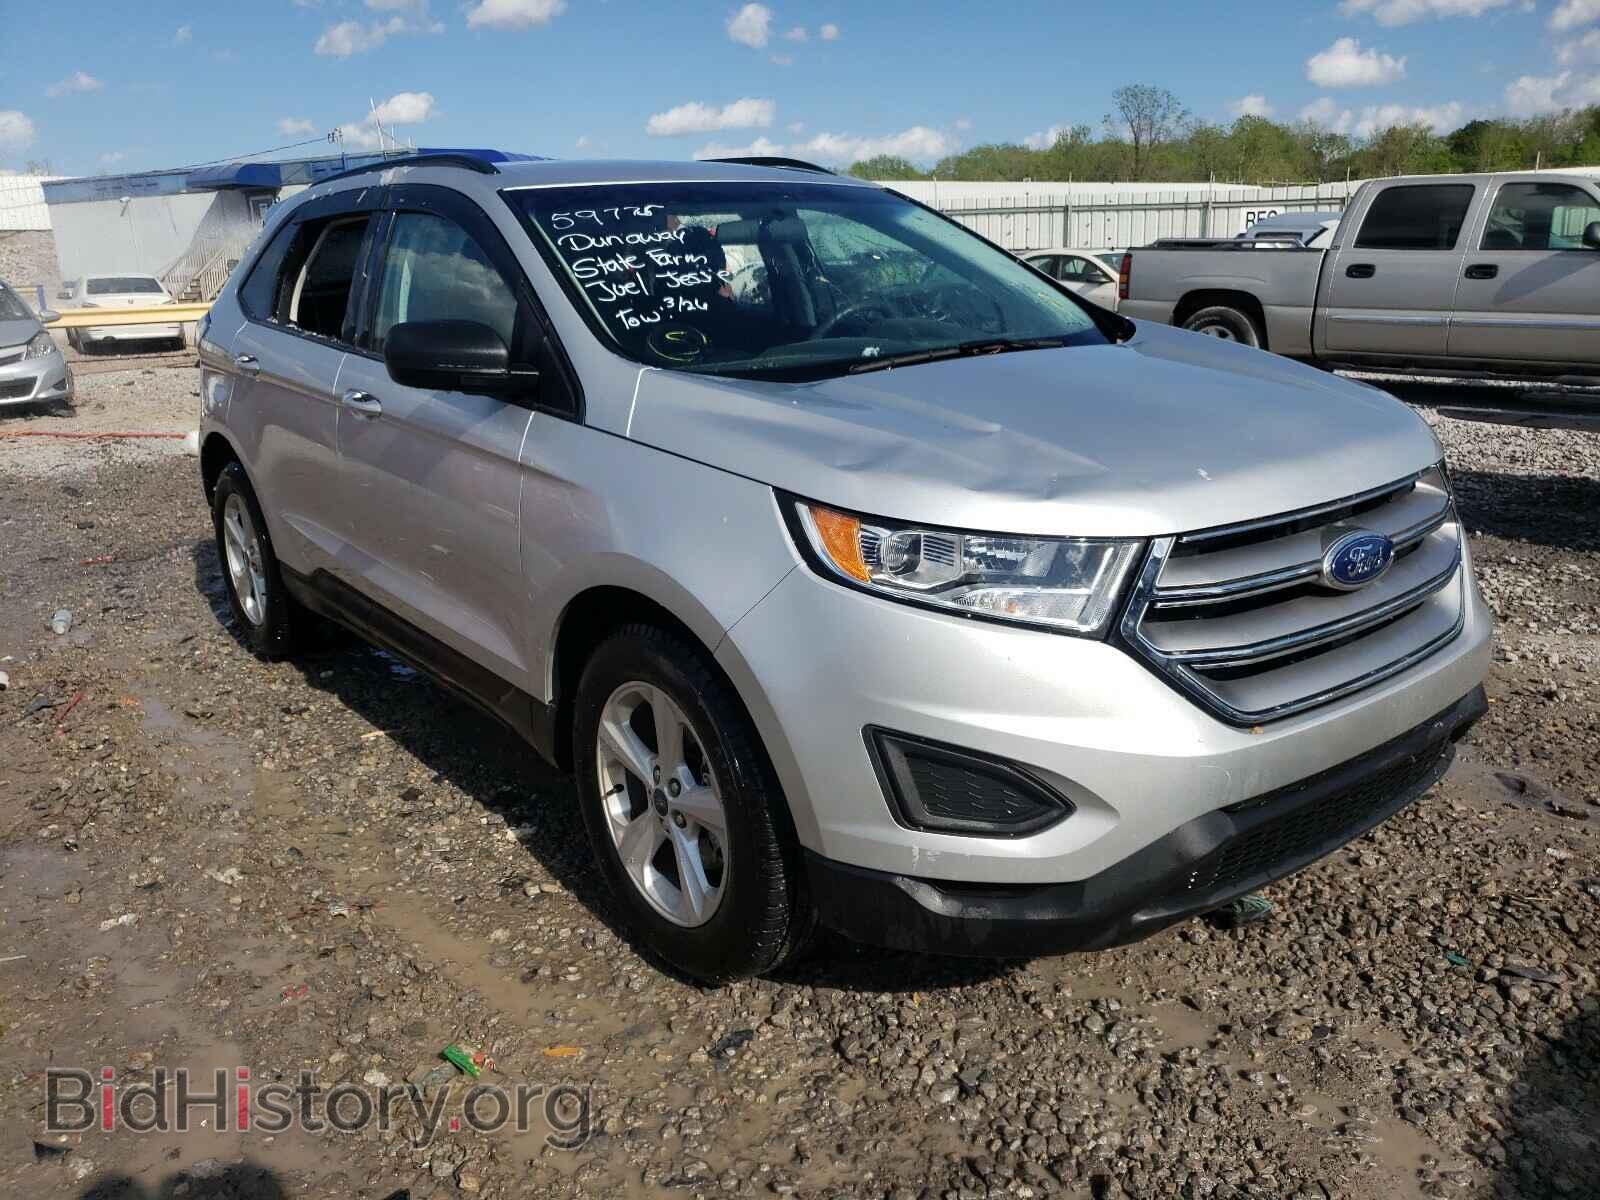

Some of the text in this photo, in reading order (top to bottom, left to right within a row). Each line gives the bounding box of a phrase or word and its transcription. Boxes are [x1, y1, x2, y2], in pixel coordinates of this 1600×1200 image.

[557, 229, 686, 252] Dunaway
[572, 248, 708, 279] State Farm
[1346, 543, 1384, 577] Ford
